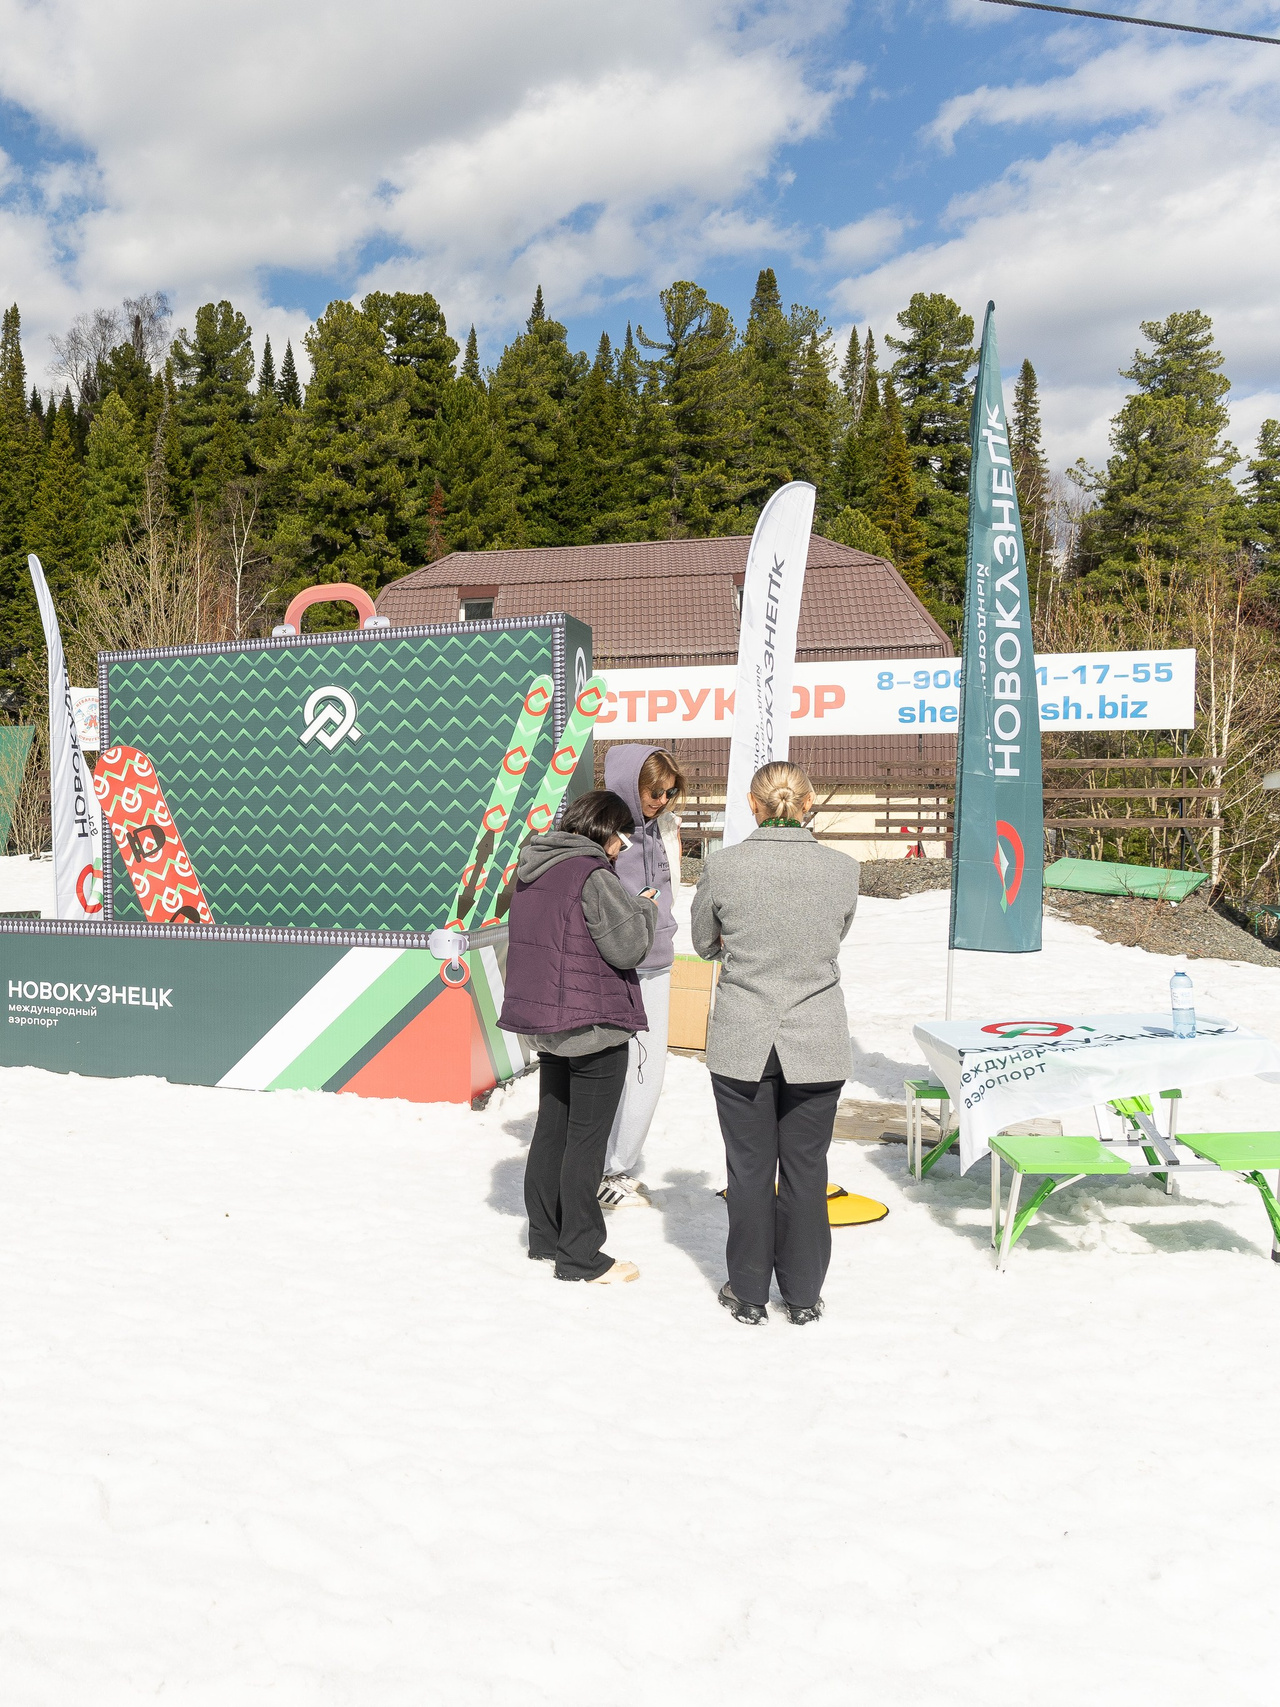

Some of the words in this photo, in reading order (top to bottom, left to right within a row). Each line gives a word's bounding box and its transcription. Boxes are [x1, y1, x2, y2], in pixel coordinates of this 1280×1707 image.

[595, 685, 846, 724] СТРУКОР
[897, 694, 1149, 723] shesh.biz
[8, 979, 173, 1010] НОВОКУЗНЕЦК
[8, 1004, 97, 1017] международный
[8, 1016, 59, 1028] аэропорт
[964, 1062, 1046, 1109] аэропорт
